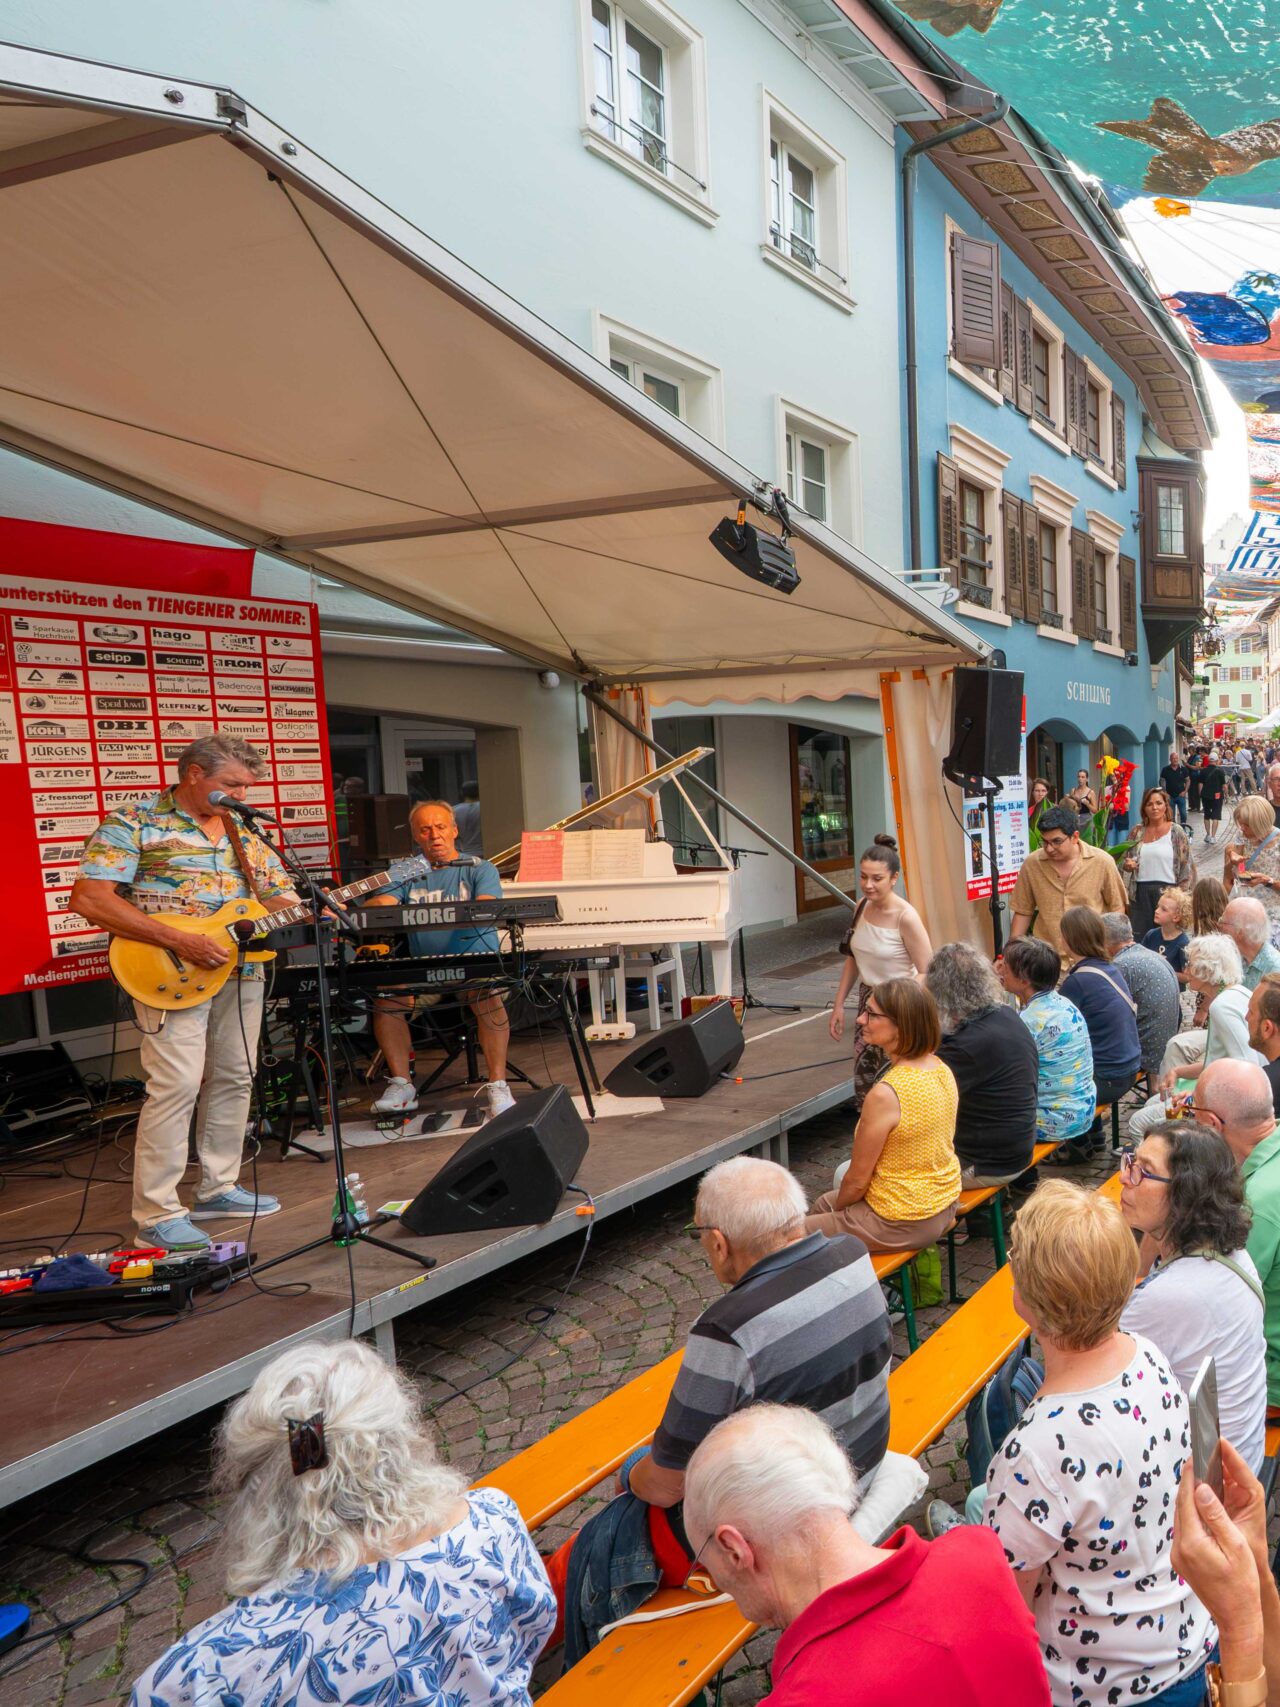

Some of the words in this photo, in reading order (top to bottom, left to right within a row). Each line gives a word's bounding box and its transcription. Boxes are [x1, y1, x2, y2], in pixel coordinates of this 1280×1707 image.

[0, 586, 108, 608] unterstützen
[113, 594, 143, 611] den
[147, 597, 235, 620] TIENGENER
[239, 605, 306, 626] SOMMER:
[32, 624, 75, 634] Sparkasse
[33, 631, 76, 641] Hochrhein
[152, 628, 192, 641] hago
[95, 652, 132, 664] seipp
[166, 657, 202, 666] SCHLEITH
[224, 659, 263, 669] FLOHR
[1066, 680, 1111, 706] SCHILLING
[97, 720, 148, 731] OBI
[222, 724, 266, 734] Simmler
[31, 745, 87, 757] JÜRGENS
[34, 769, 92, 778] arzner
[48, 793, 94, 802] fressnapf
[297, 807, 325, 817] KÖGEL
[402, 906, 456, 926] KORG
[426, 967, 466, 982] KORG
[141, 1285, 162, 1293] novo
